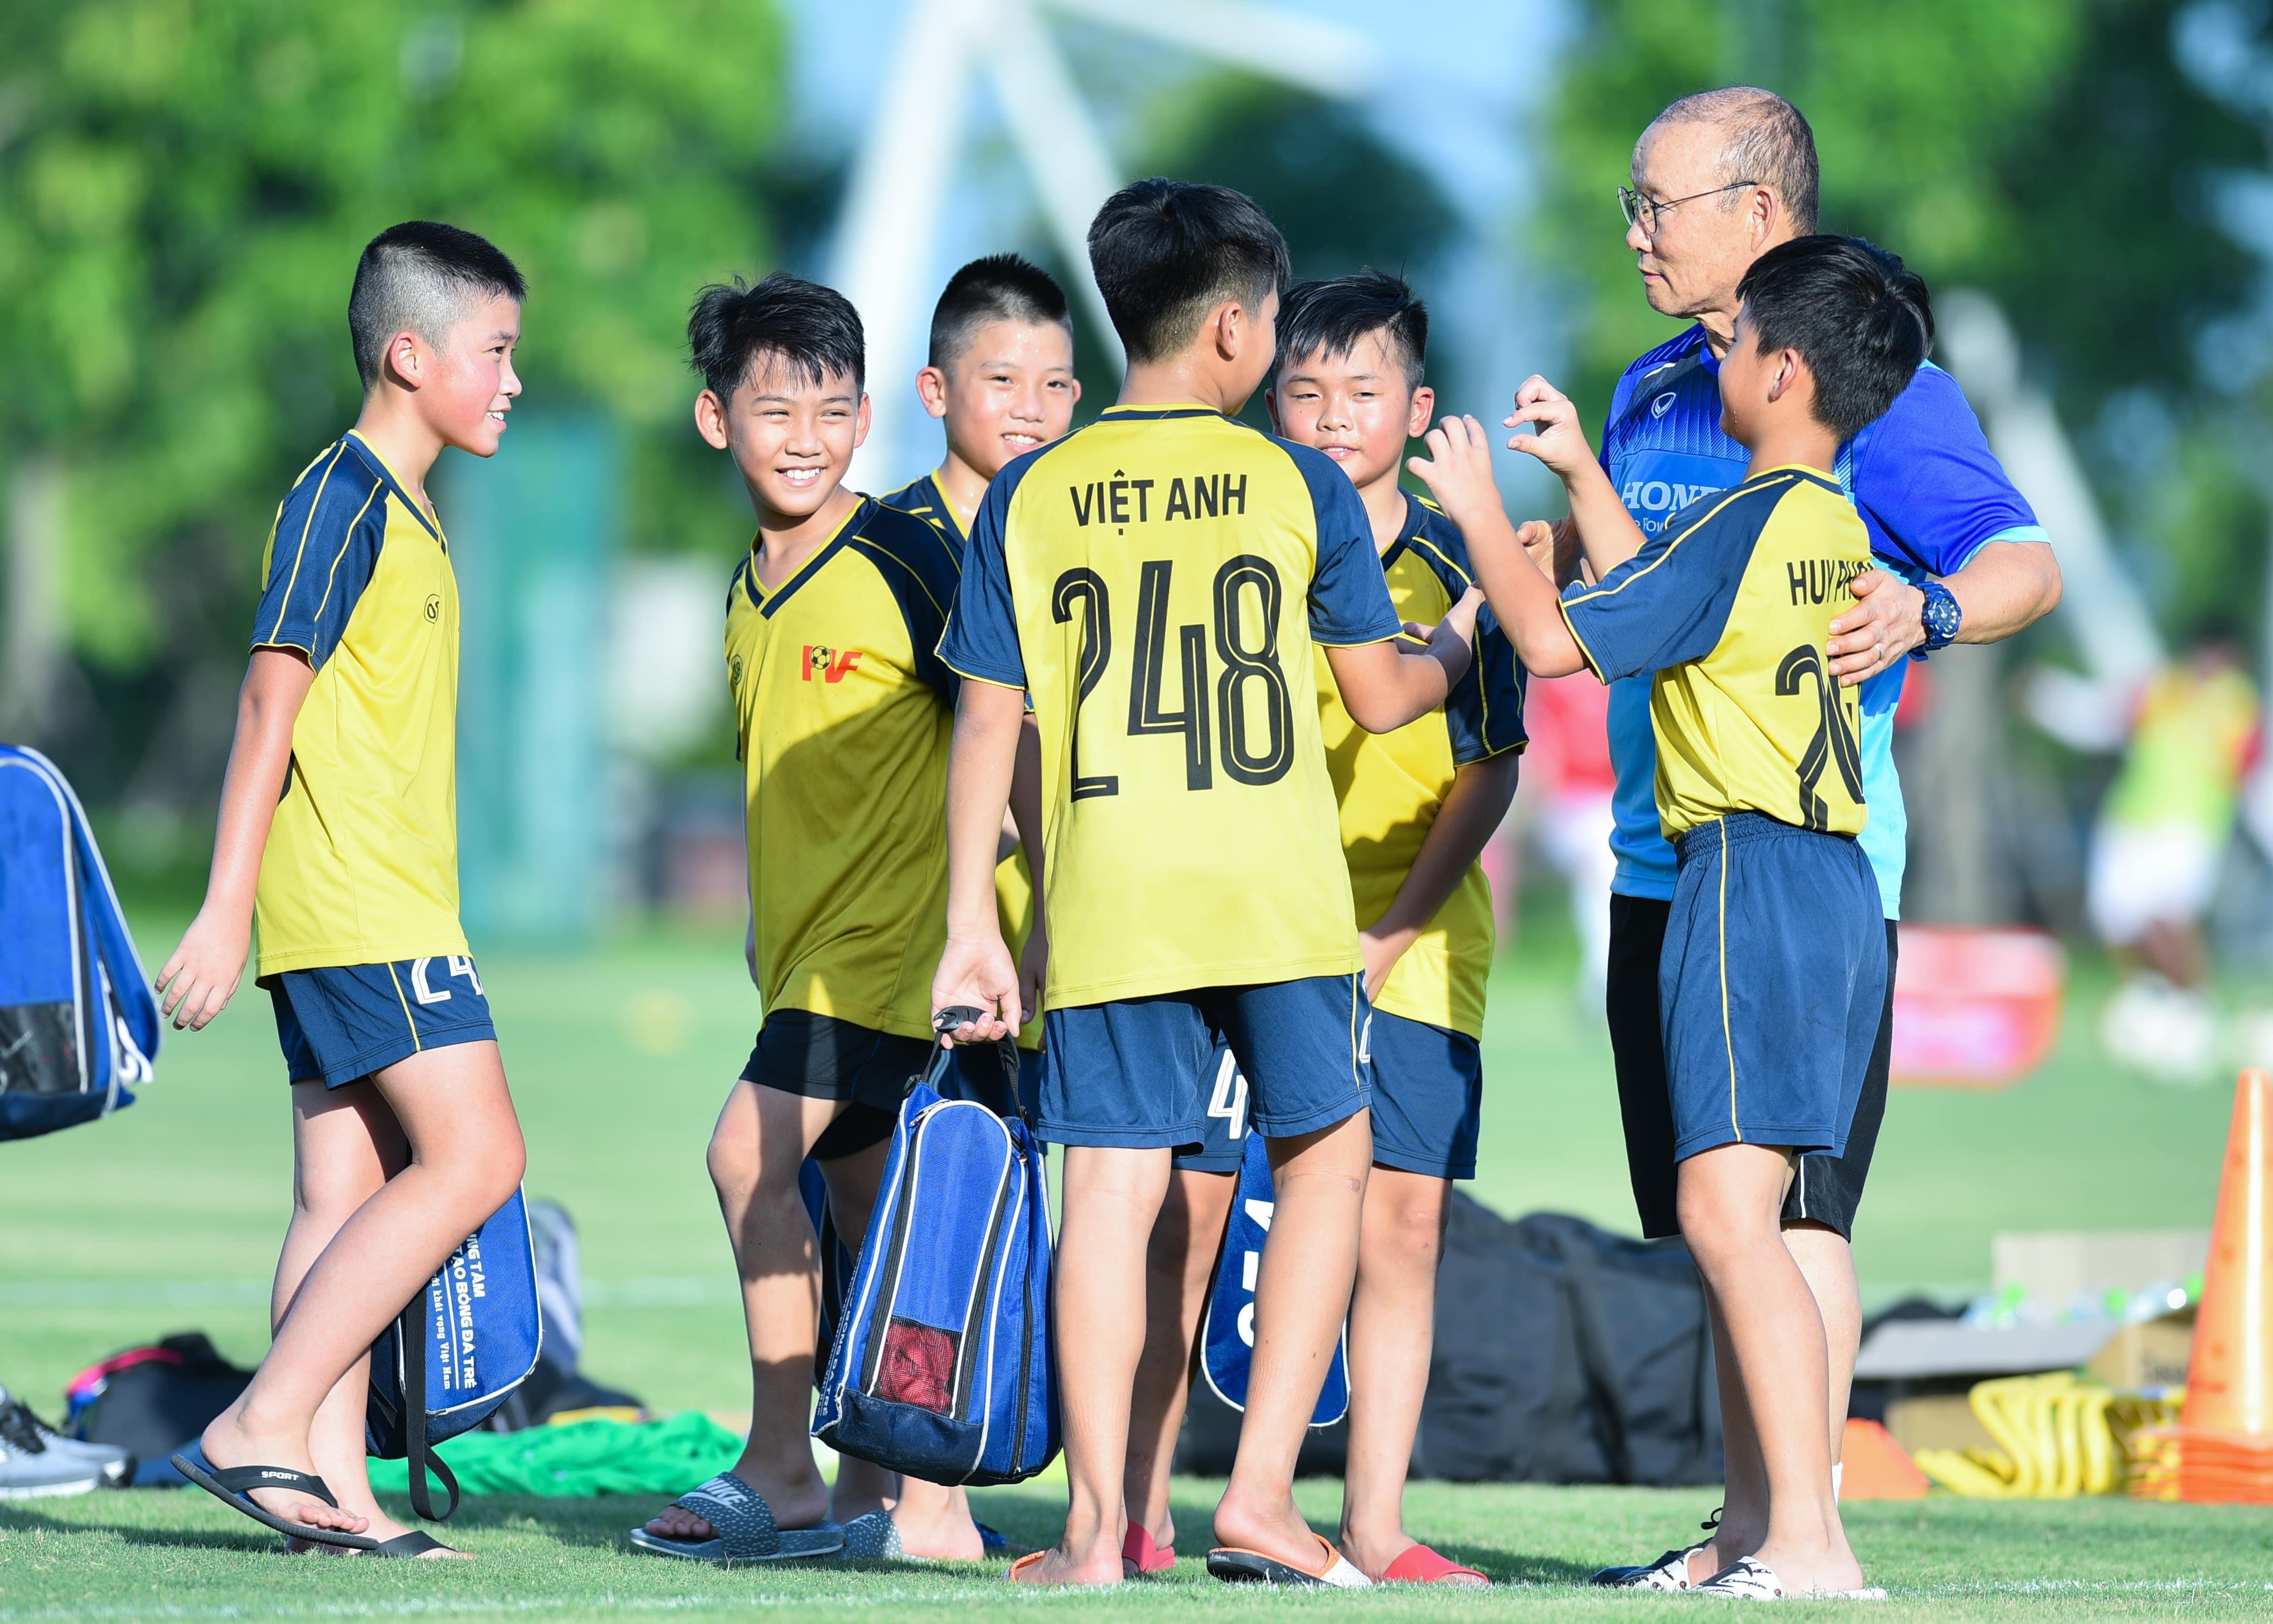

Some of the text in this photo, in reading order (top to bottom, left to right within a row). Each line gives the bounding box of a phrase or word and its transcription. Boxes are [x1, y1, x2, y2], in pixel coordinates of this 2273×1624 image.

[1070, 469, 1247, 535] VIỆT ANH
[1621, 481, 1721, 511] HON
[1786, 559, 1835, 606] HUY
[1051, 554, 1295, 803] 248
[411, 955, 483, 1005] 24
[456, 1281, 473, 1328] BÓNG
[439, 1341, 450, 1363] Việt
[442, 1366, 451, 1390] Nam
[261, 1471, 299, 1481] SPORT
[696, 1477, 749, 1505] NIKE
